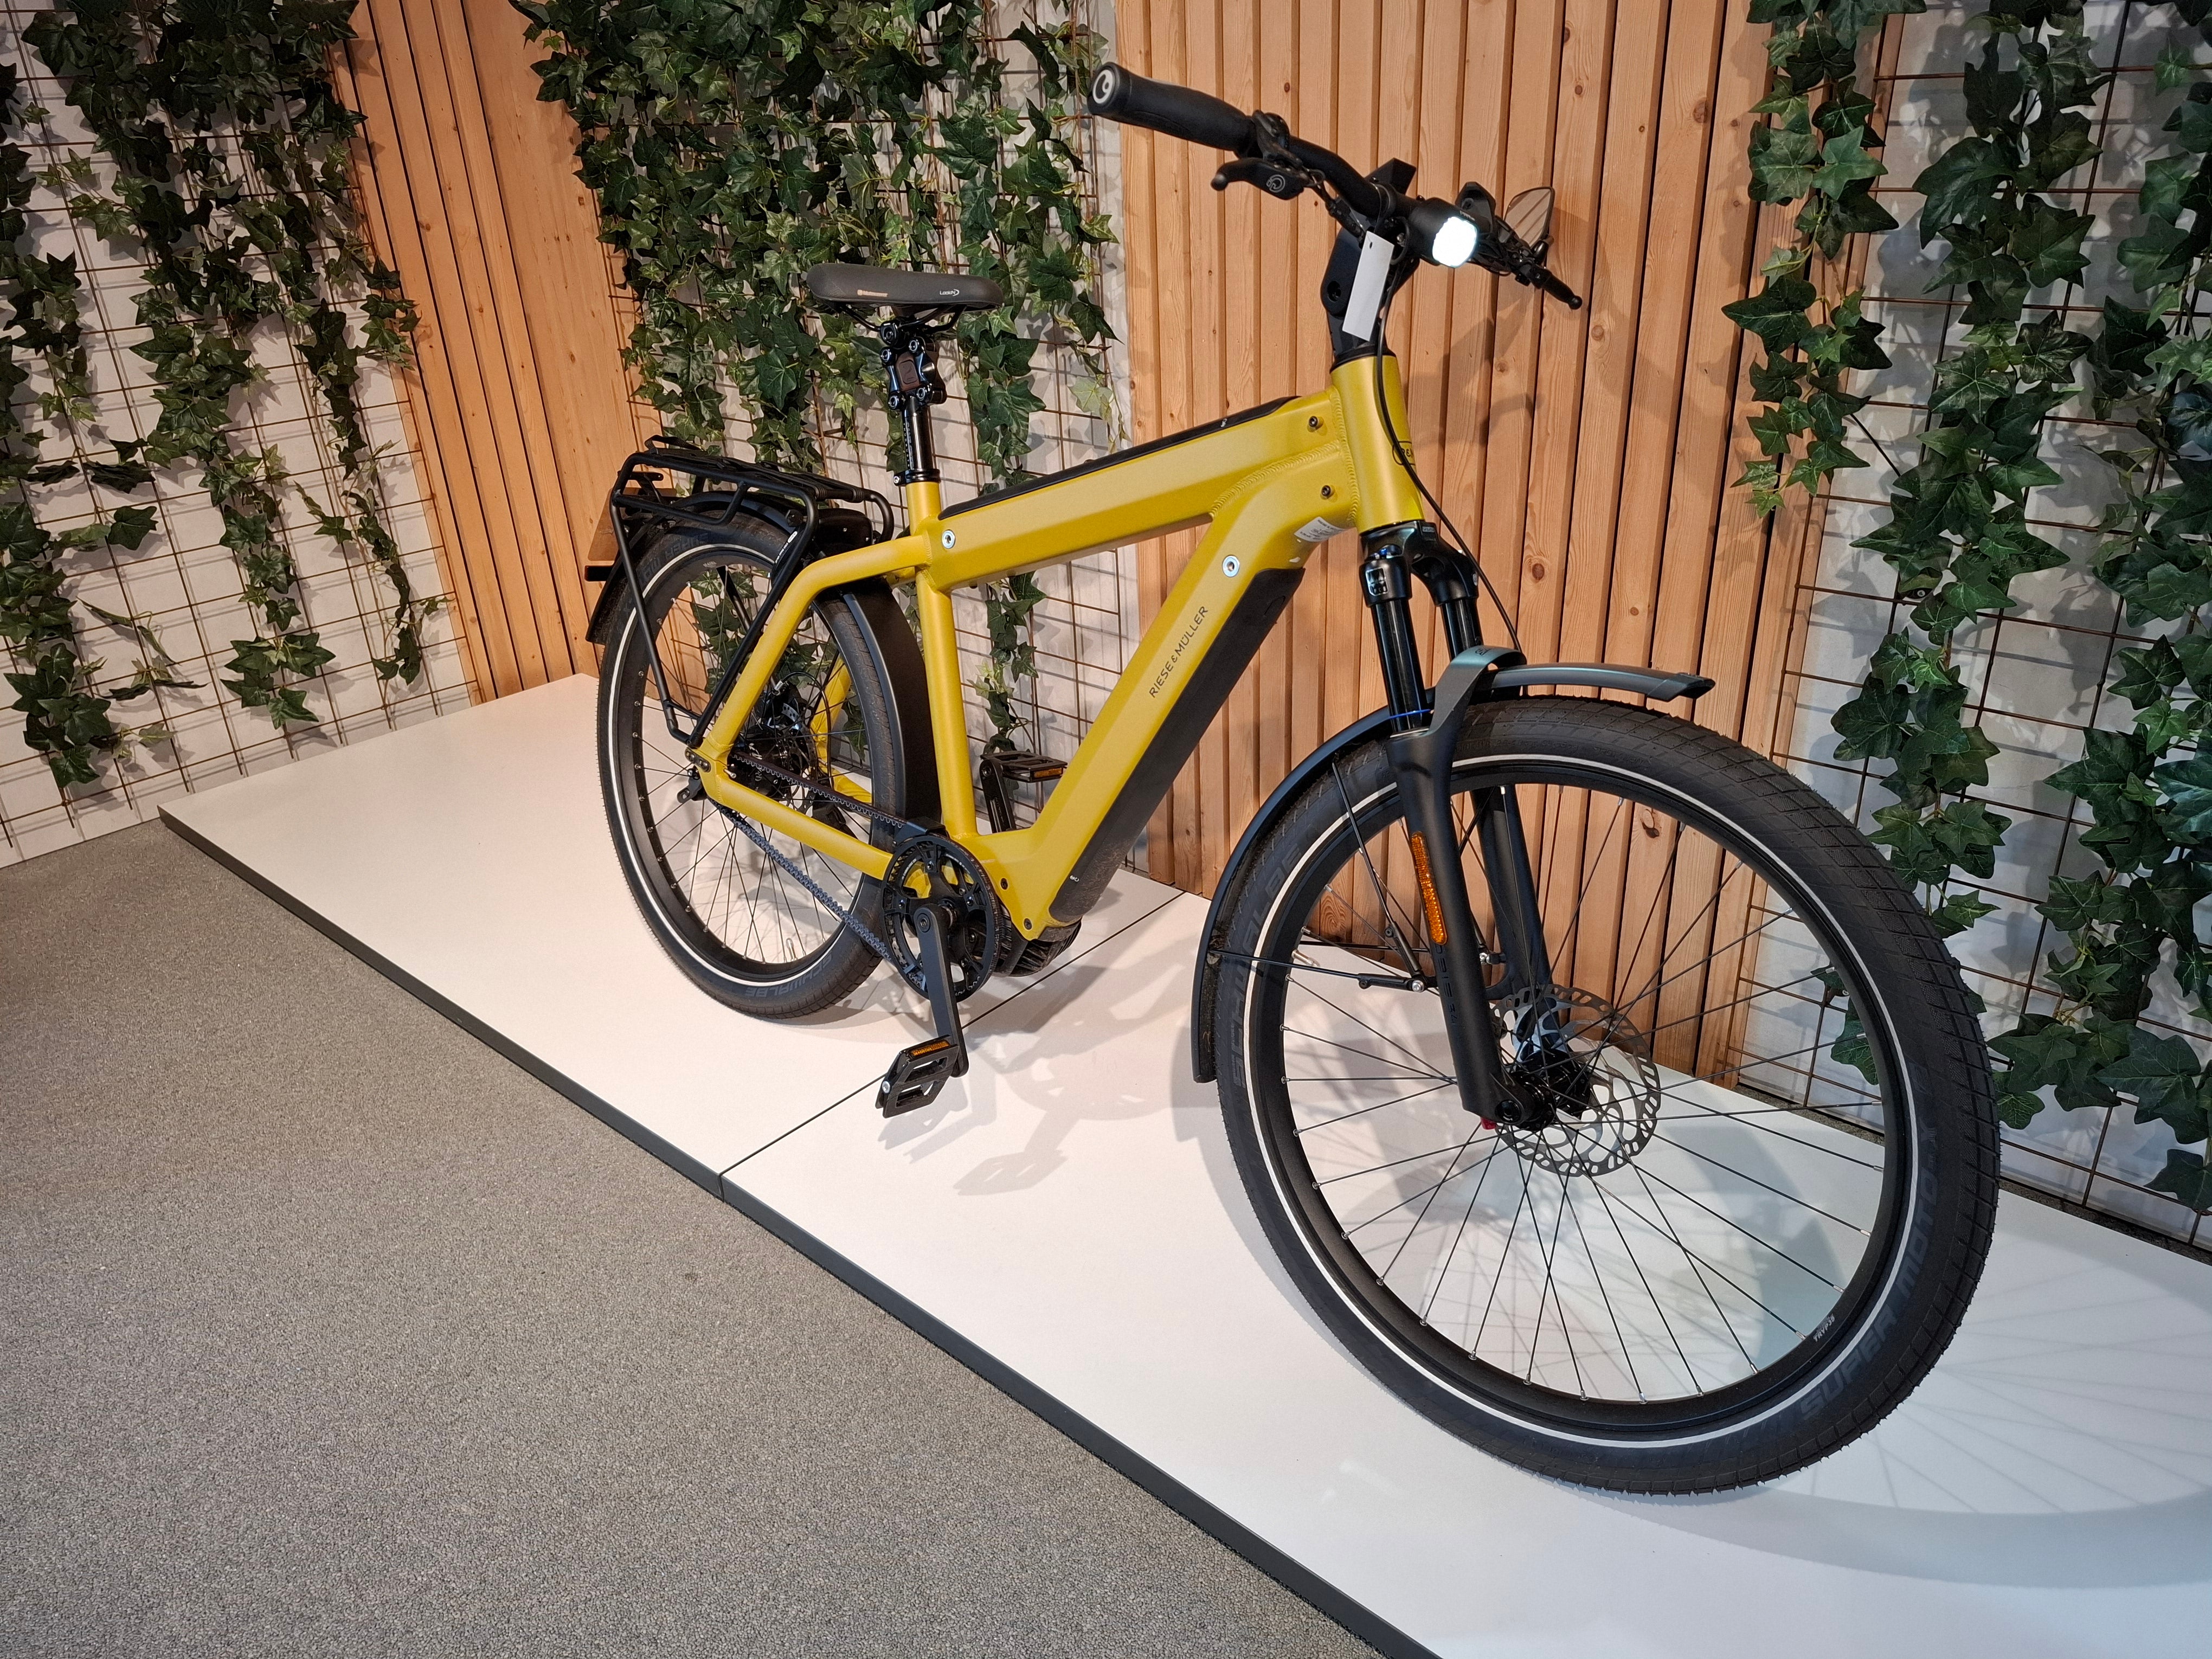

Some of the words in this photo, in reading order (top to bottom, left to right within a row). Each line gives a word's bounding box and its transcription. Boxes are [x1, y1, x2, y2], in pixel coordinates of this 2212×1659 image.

[1149, 661, 1173, 698] RIESE
[1175, 606, 1208, 656] MÜLLER
[1799, 1305, 1897, 1419] SUPER
